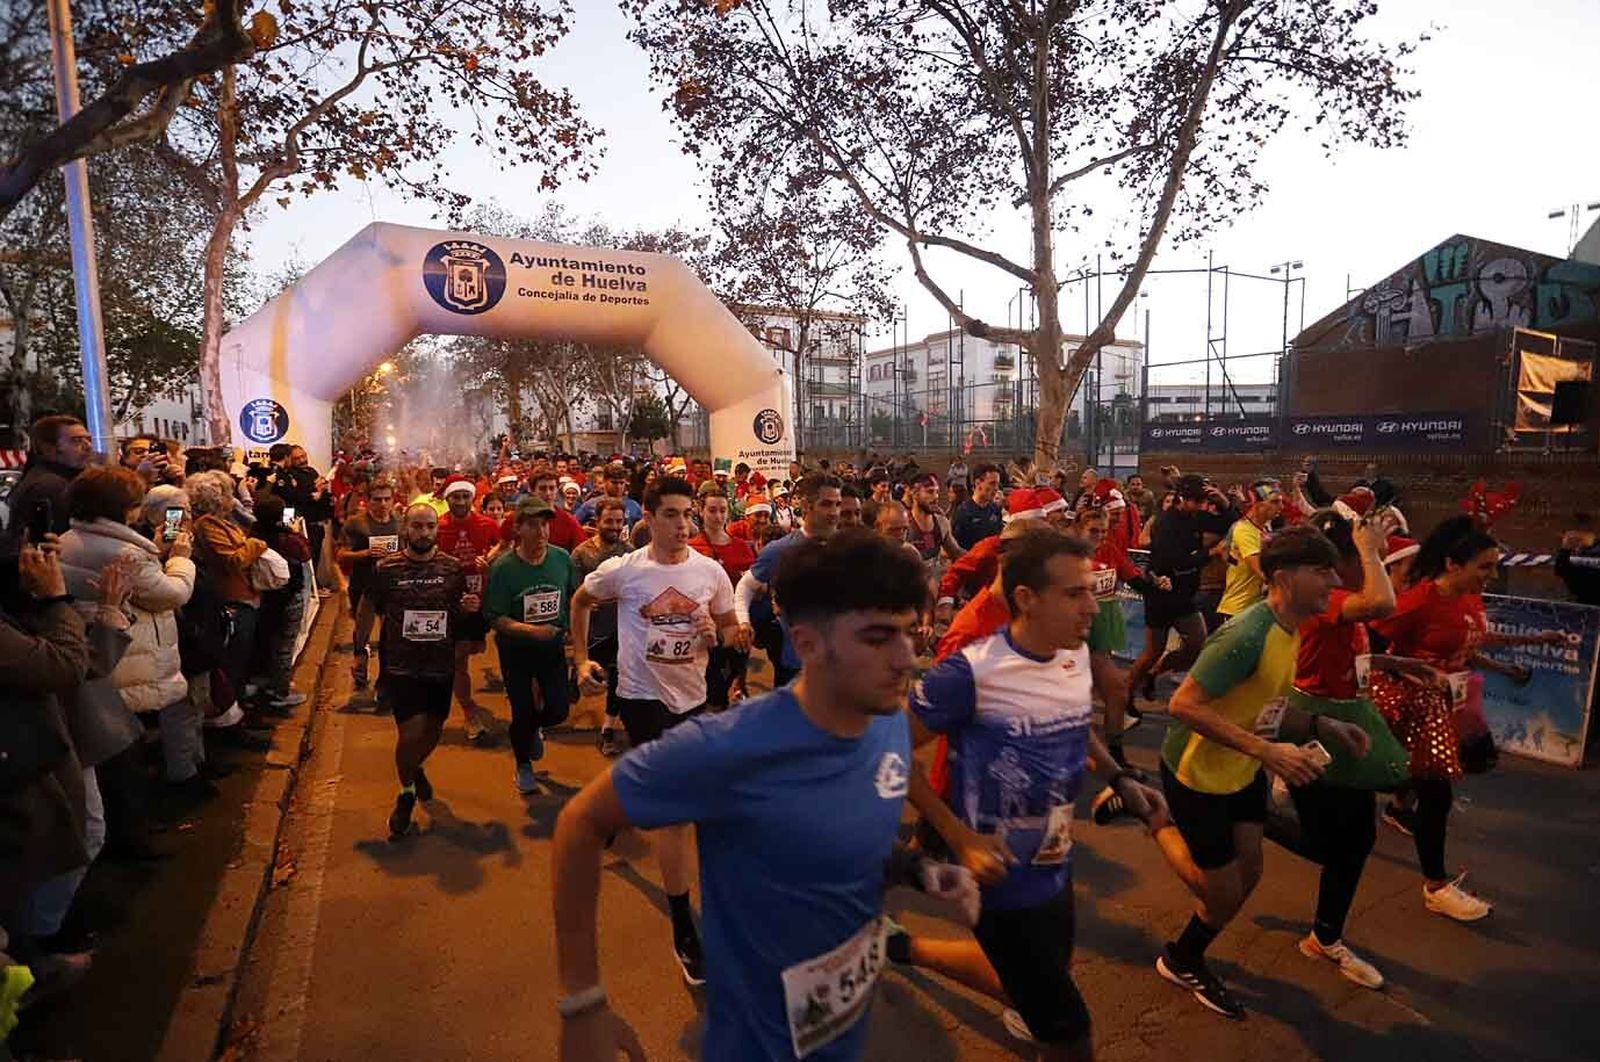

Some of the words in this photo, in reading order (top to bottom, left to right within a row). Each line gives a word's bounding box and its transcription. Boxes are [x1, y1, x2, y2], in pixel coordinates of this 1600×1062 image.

[510, 252, 646, 276] Ayuntamiento
[551, 271, 575, 286] de
[582, 274, 647, 292] Huelva
[582, 292, 597, 302] de
[600, 293, 650, 306] Deportes
[1228, 426, 1270, 435] HYUNDAI
[1312, 423, 1363, 433] HYUNDAI
[1401, 420, 1462, 431] HYUNDAI
[1165, 428, 1201, 437] HYUNDAI
[425, 620, 440, 632] 54
[673, 640, 691, 656] 82
